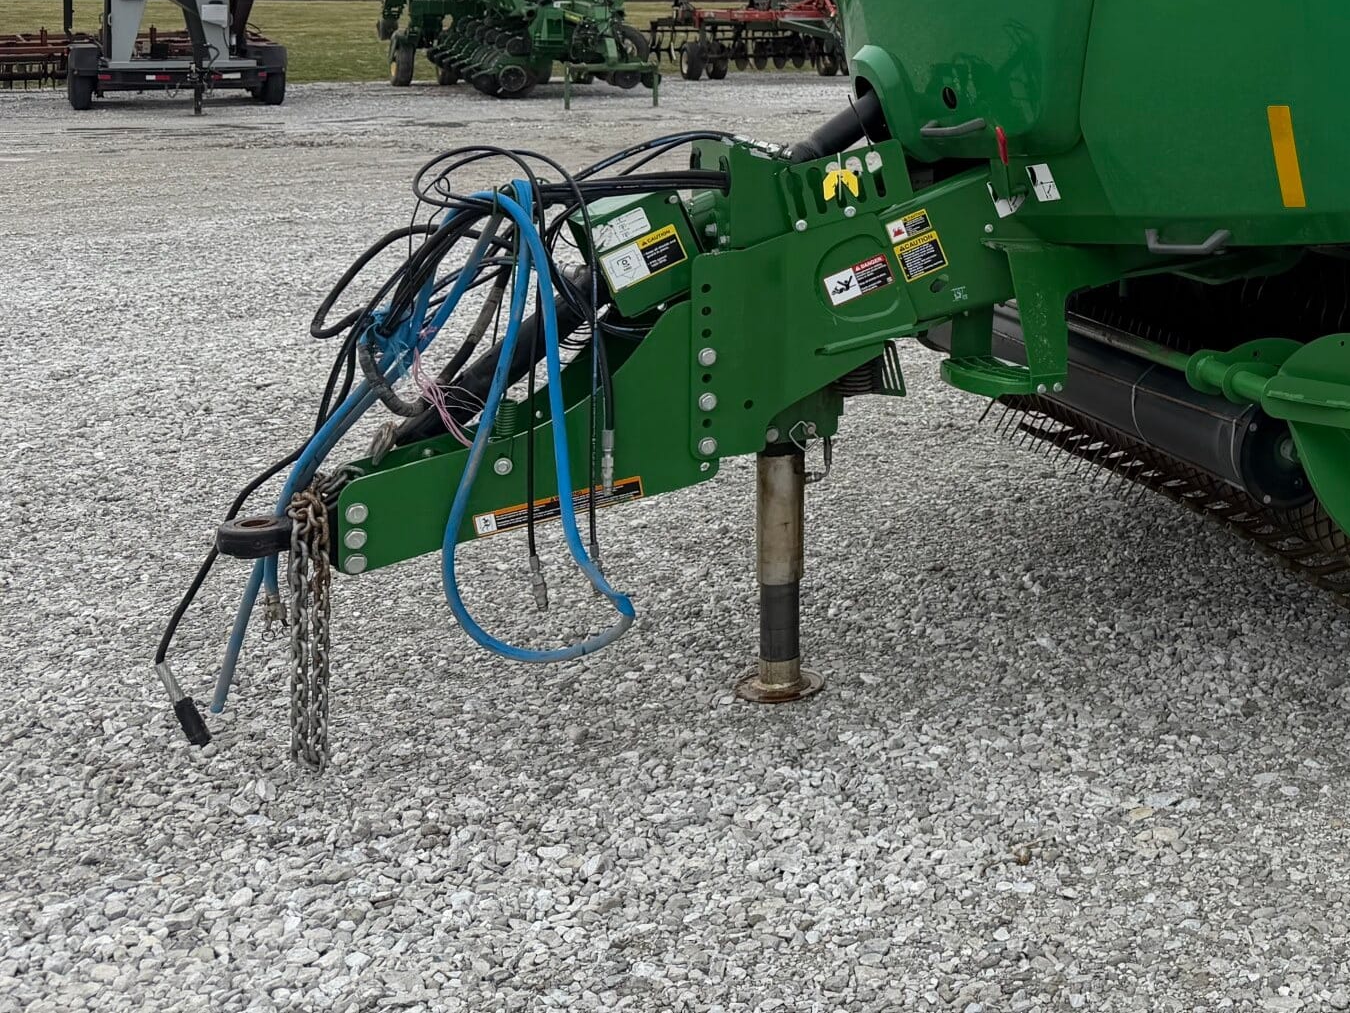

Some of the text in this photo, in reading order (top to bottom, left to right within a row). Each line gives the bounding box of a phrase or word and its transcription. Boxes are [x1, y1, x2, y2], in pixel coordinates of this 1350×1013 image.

[646, 229, 672, 244] CAUTION
[904, 234, 934, 249] CAUTION
[860, 256, 882, 269] DANGER
